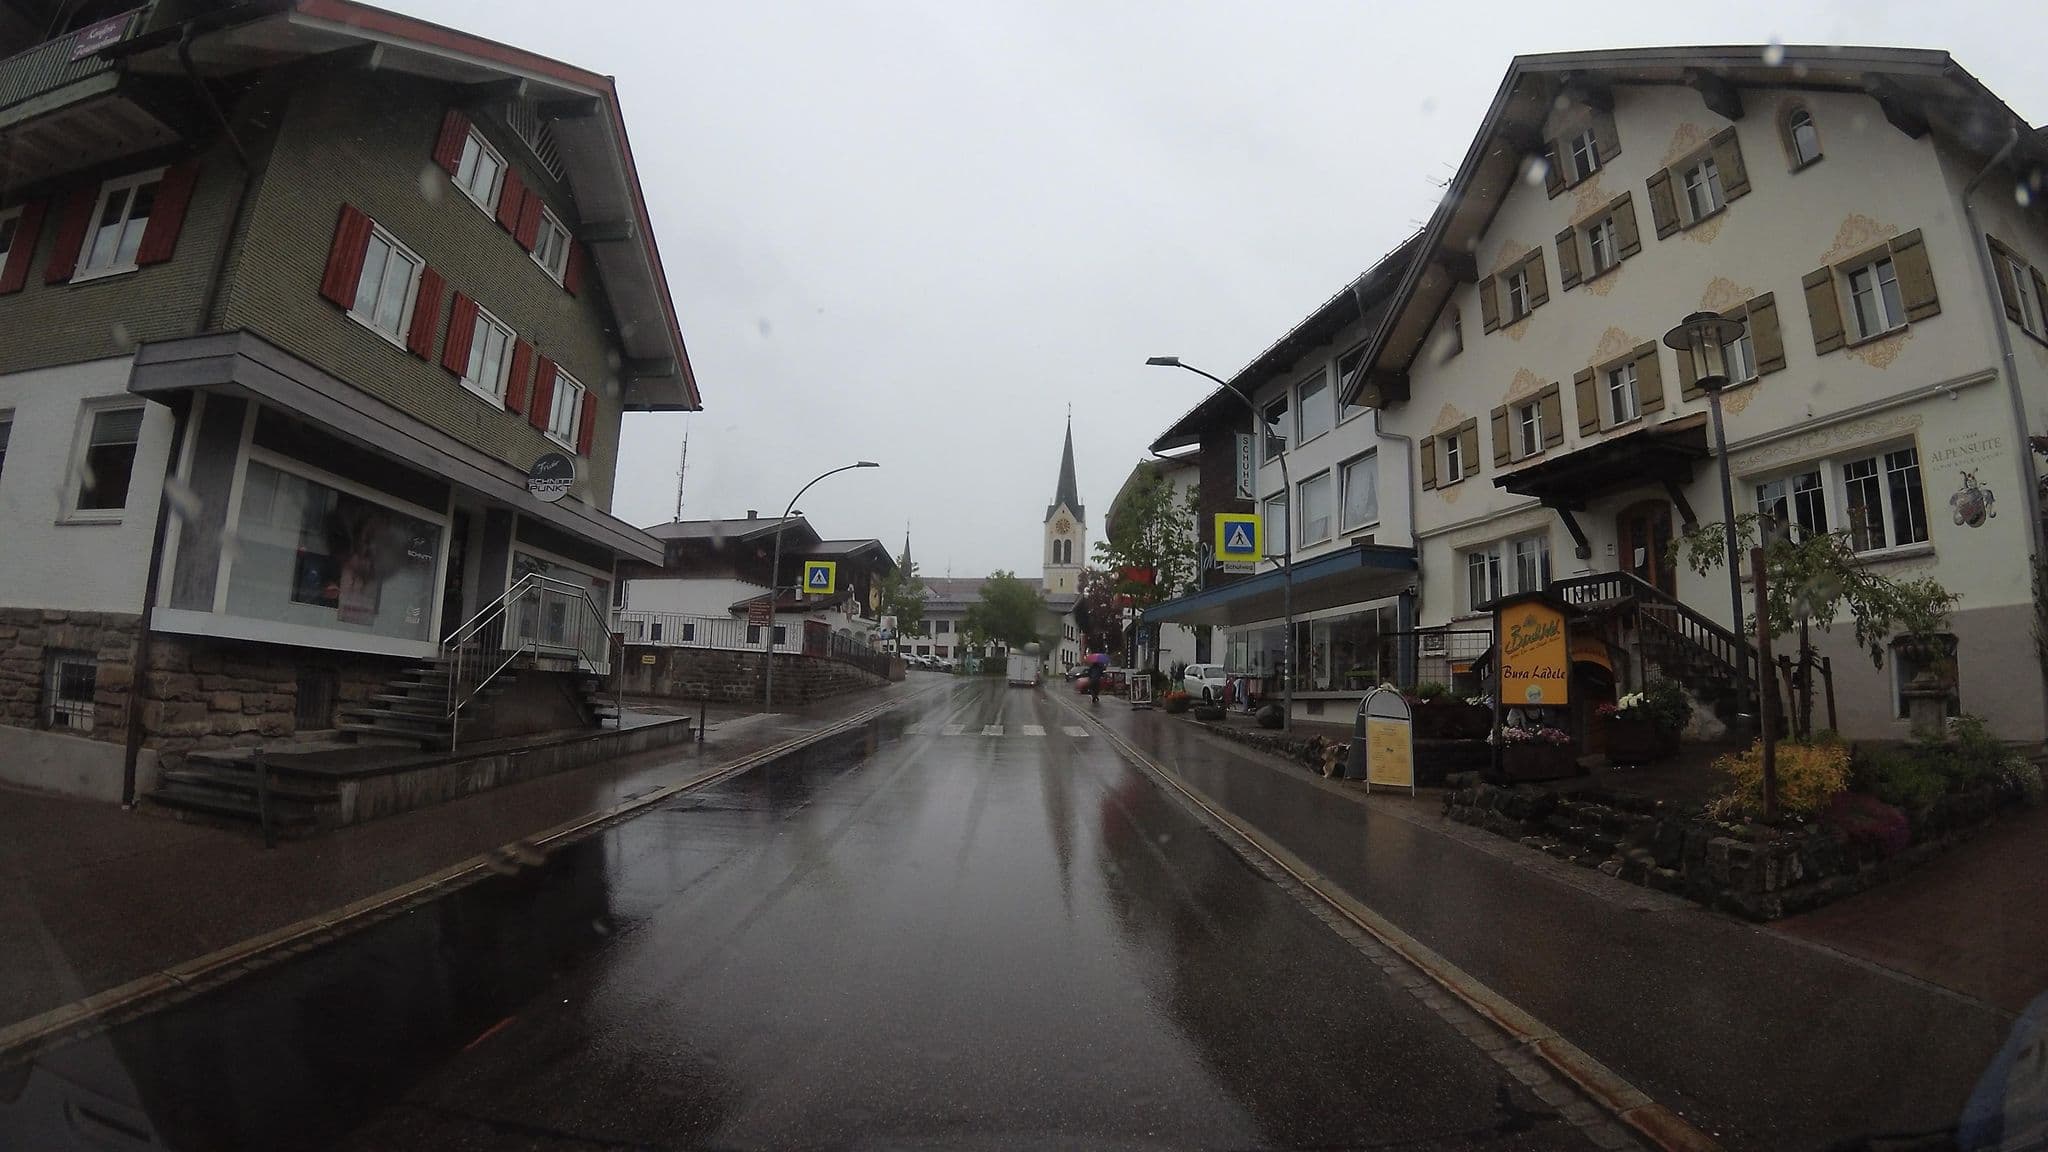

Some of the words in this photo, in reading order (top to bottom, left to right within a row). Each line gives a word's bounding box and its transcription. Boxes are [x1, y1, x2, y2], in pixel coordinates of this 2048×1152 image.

[1931, 437, 2001, 463] ALPENSUITE
[1242, 437, 1250, 488] SCHUHE
[529, 485, 571, 493] PUNKT
[1225, 563, 1254, 571] Schulweg
[1502, 665, 1529, 679] Bura
